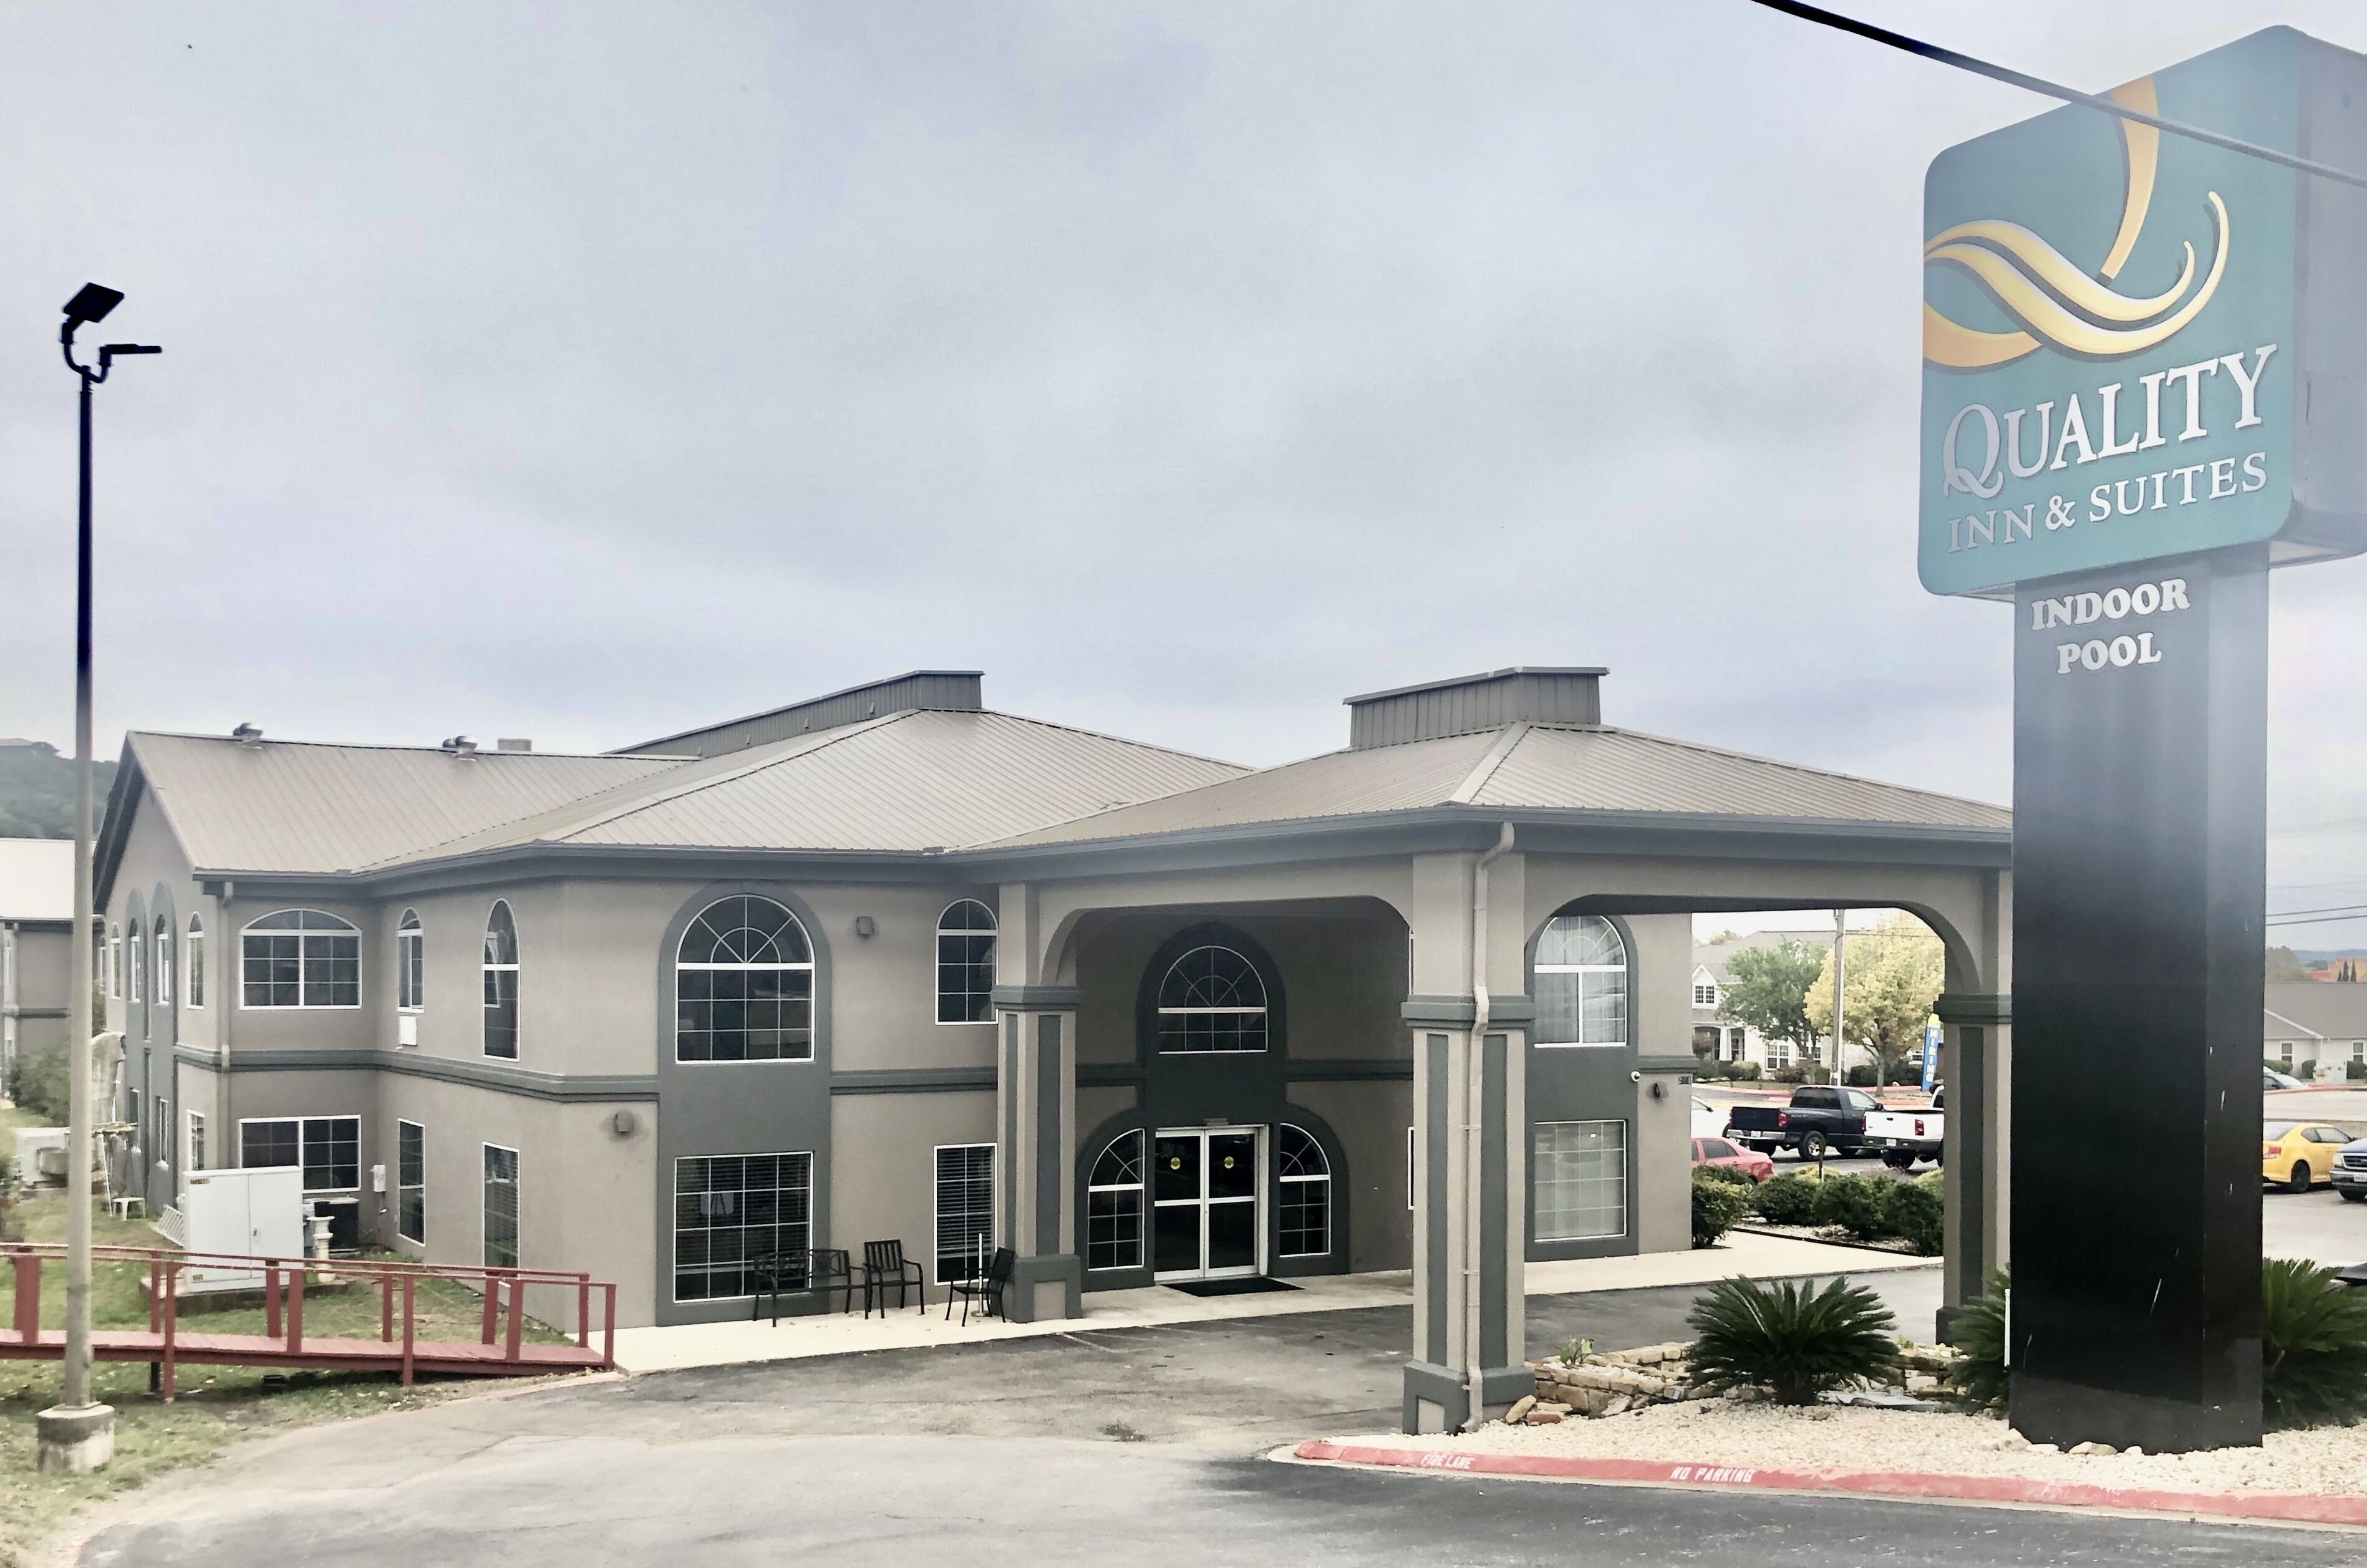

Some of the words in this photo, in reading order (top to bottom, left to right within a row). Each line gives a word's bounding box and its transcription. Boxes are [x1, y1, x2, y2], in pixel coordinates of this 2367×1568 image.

[1943, 344, 2277, 499] QUALITY
[1947, 503, 2035, 553] INN
[2045, 495, 2076, 531] &
[2089, 451, 2268, 522] SUITES
[2031, 578, 2191, 631] INDOOR
[2056, 632, 2163, 674] POOL
[1445, 1455, 1476, 1470] LANE
[1670, 1466, 1692, 1480] NO
[1695, 1467, 1756, 1483] PARKING
